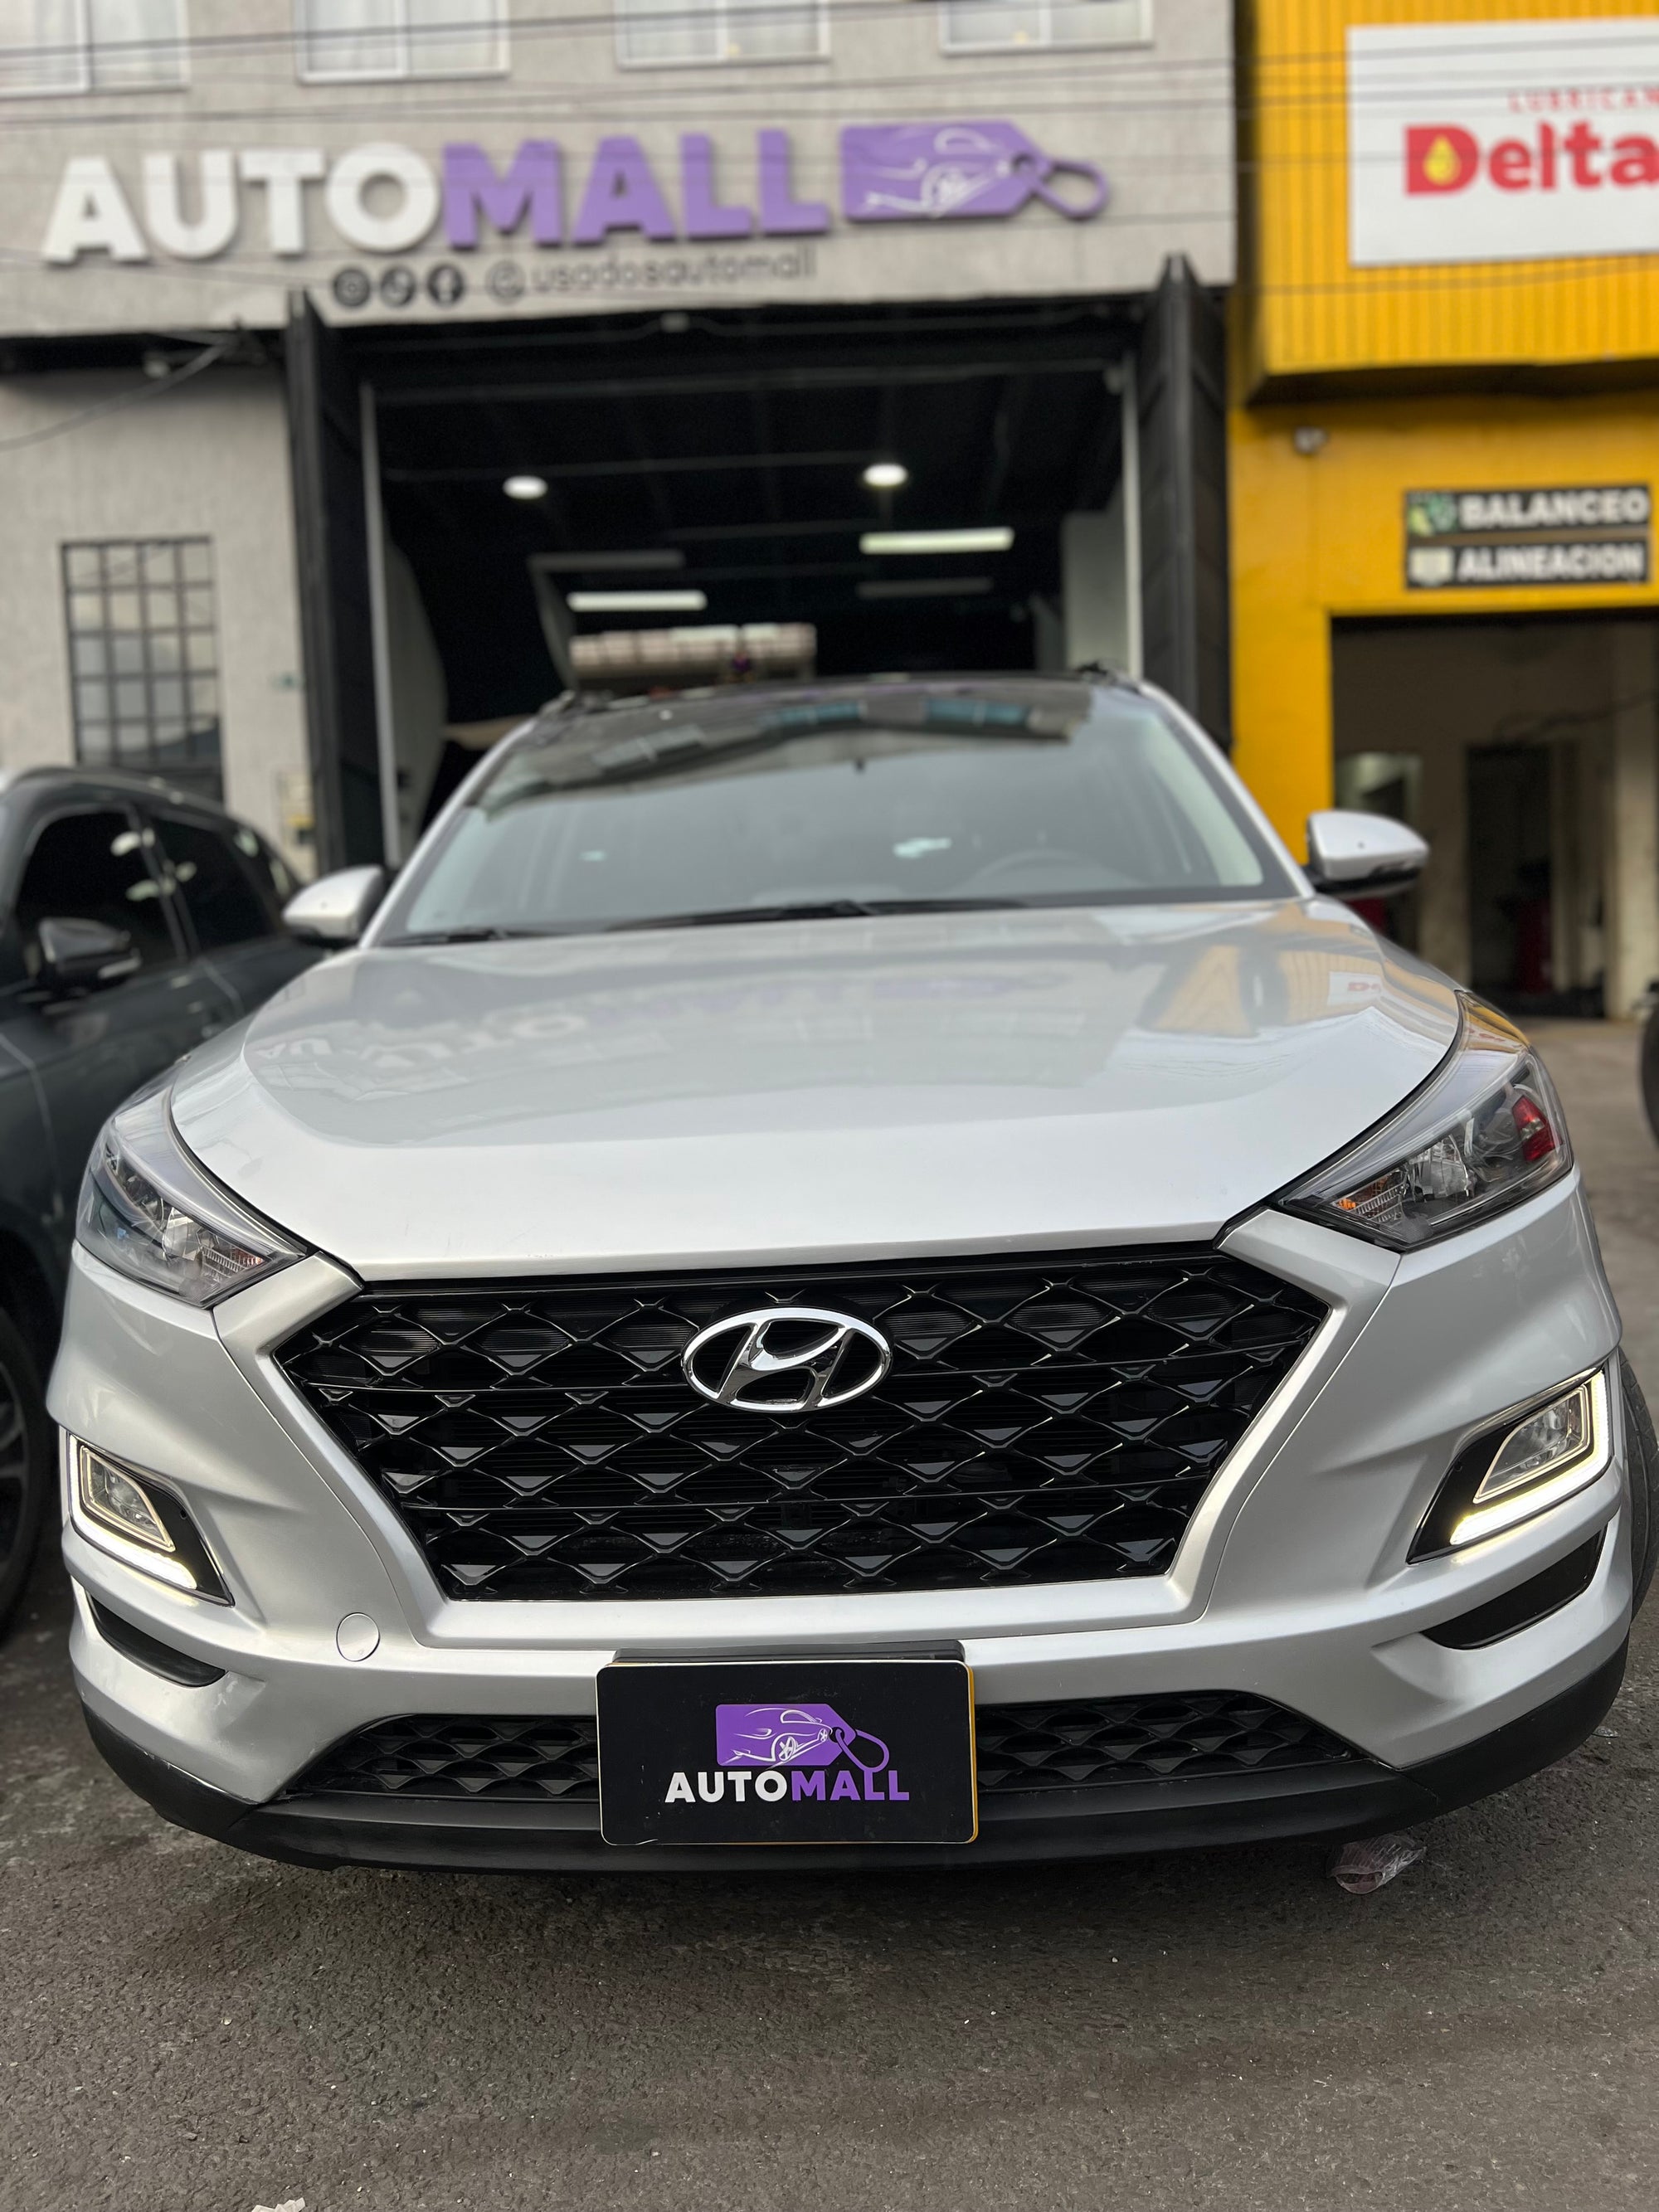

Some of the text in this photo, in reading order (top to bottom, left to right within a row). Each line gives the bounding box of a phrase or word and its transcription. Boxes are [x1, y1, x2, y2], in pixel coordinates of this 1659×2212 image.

[1405, 120, 1659, 196] Delta
[43, 129, 828, 264] AUTOMALL
[1461, 489, 1648, 529] BALANCEO
[664, 1770, 910, 1803] AUTOMALL
